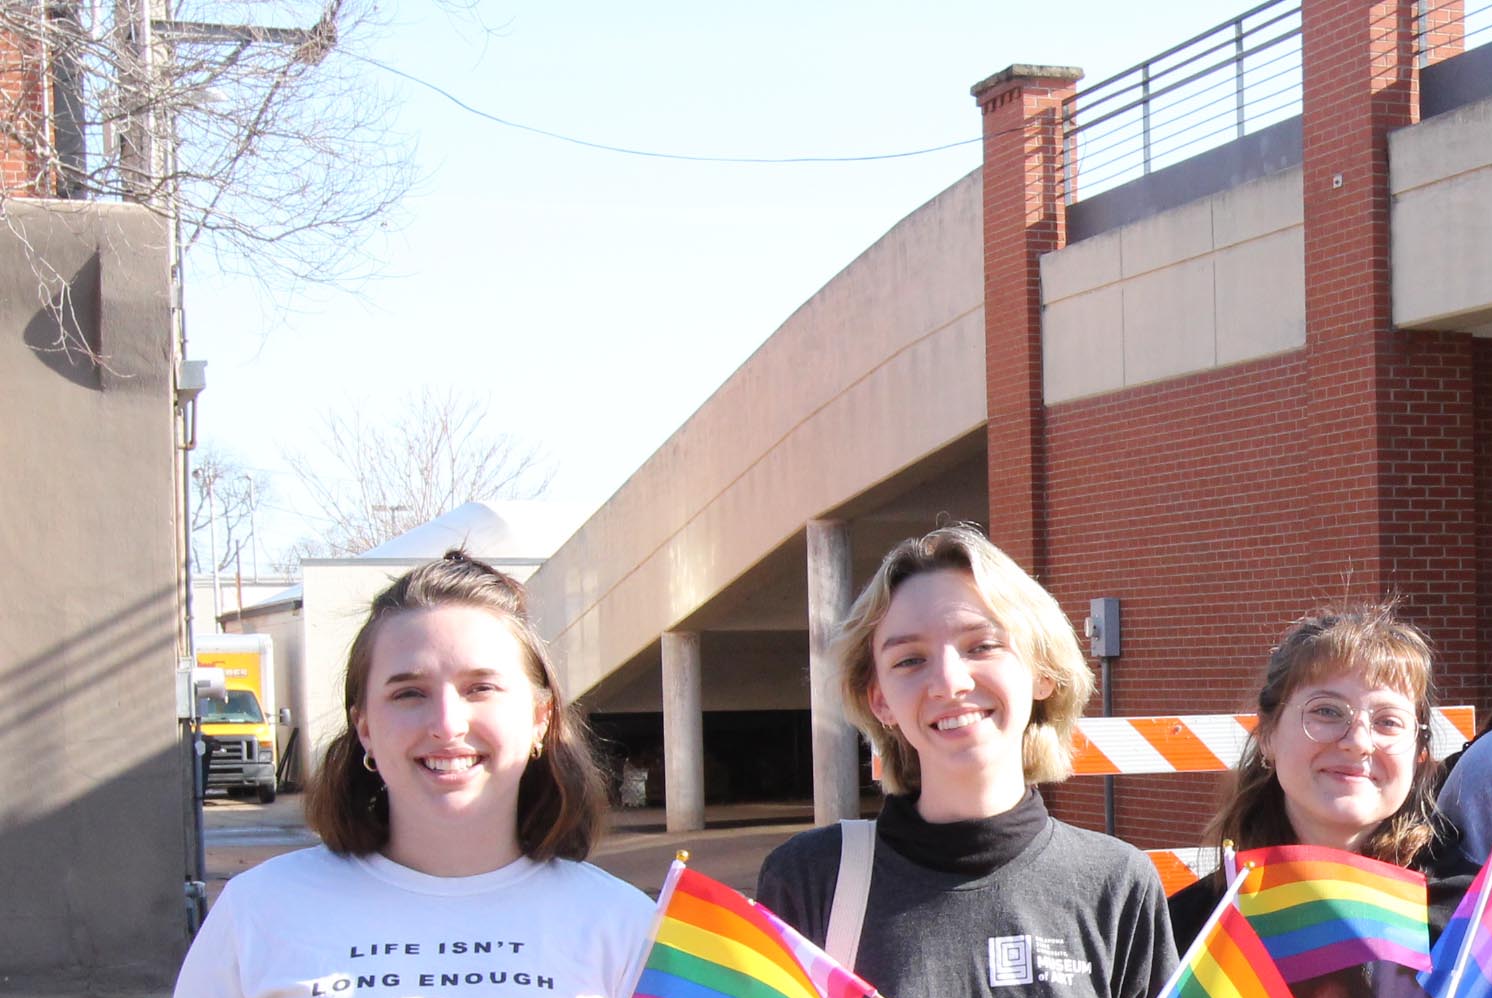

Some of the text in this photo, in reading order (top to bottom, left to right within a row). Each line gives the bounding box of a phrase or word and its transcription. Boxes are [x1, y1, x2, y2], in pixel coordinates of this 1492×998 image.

[350, 941, 525, 958] LIFE ISN'T
[1036, 955, 1092, 975] MUSEUM
[312, 971, 555, 997] LONG ENOUGH
